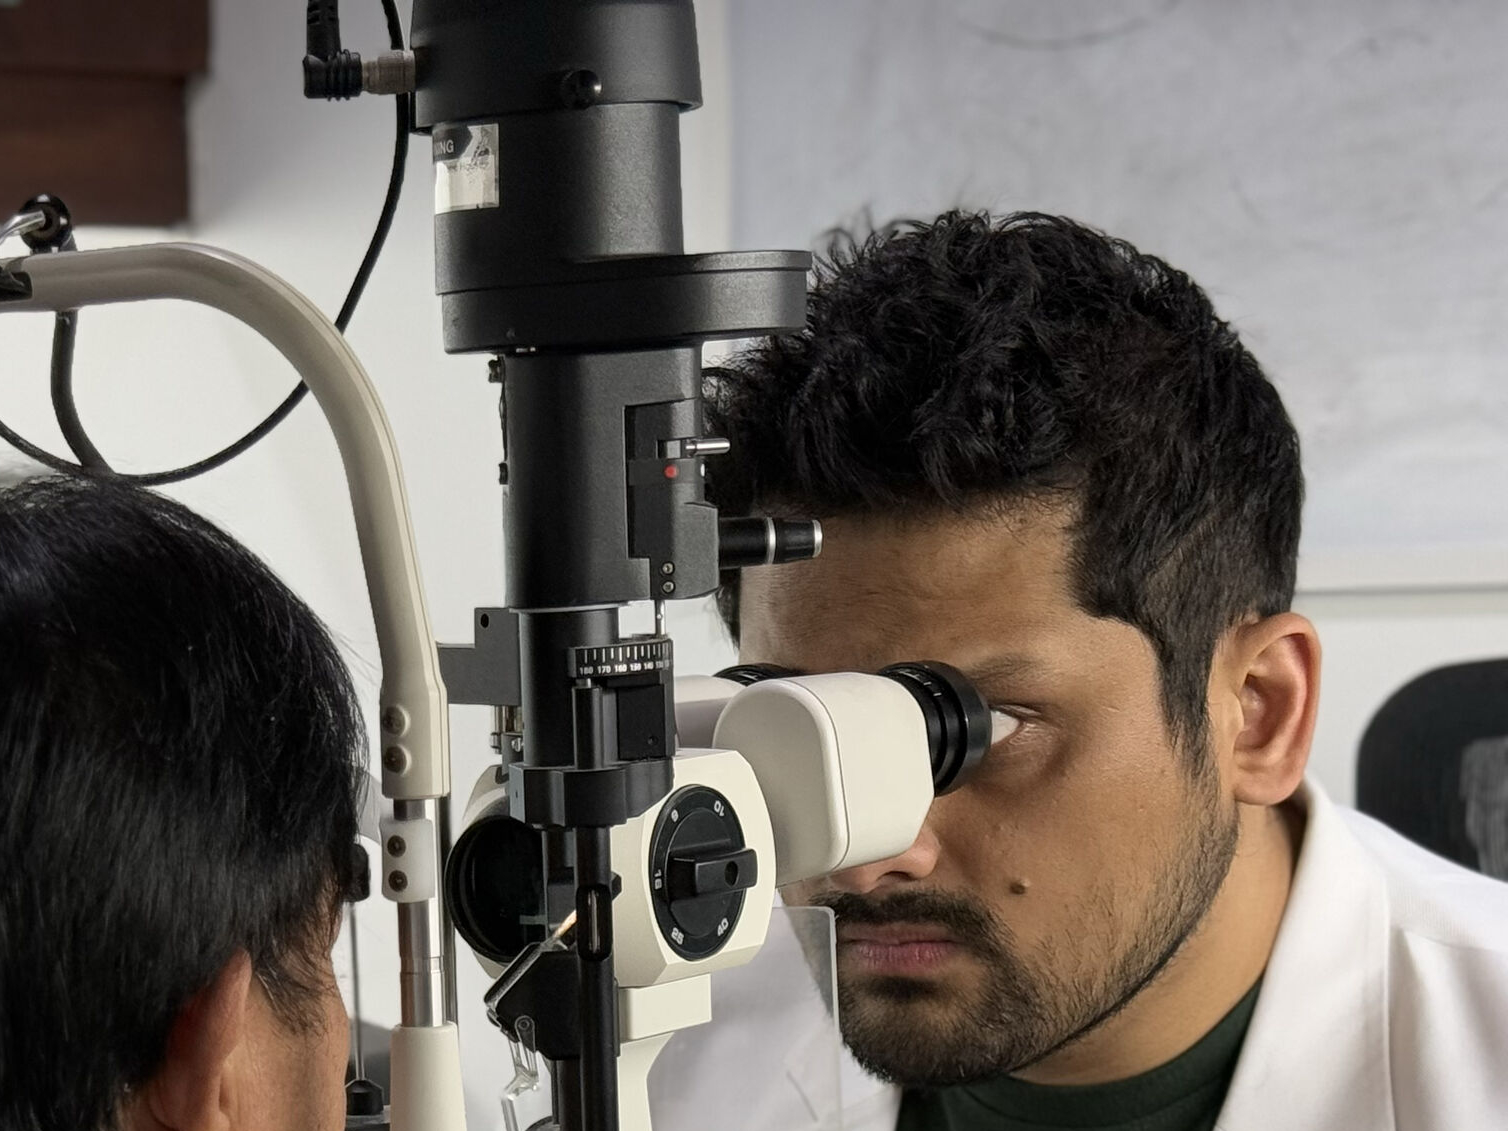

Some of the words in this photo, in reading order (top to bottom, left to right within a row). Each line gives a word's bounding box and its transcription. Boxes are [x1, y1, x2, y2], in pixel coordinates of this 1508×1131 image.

[598, 664, 611, 674] 170
[614, 663, 627, 673] 160
[630, 662, 641, 671] 150
[713, 800, 725, 817] 10
[717, 917, 729, 937] 40
[671, 927, 684, 945] 25
